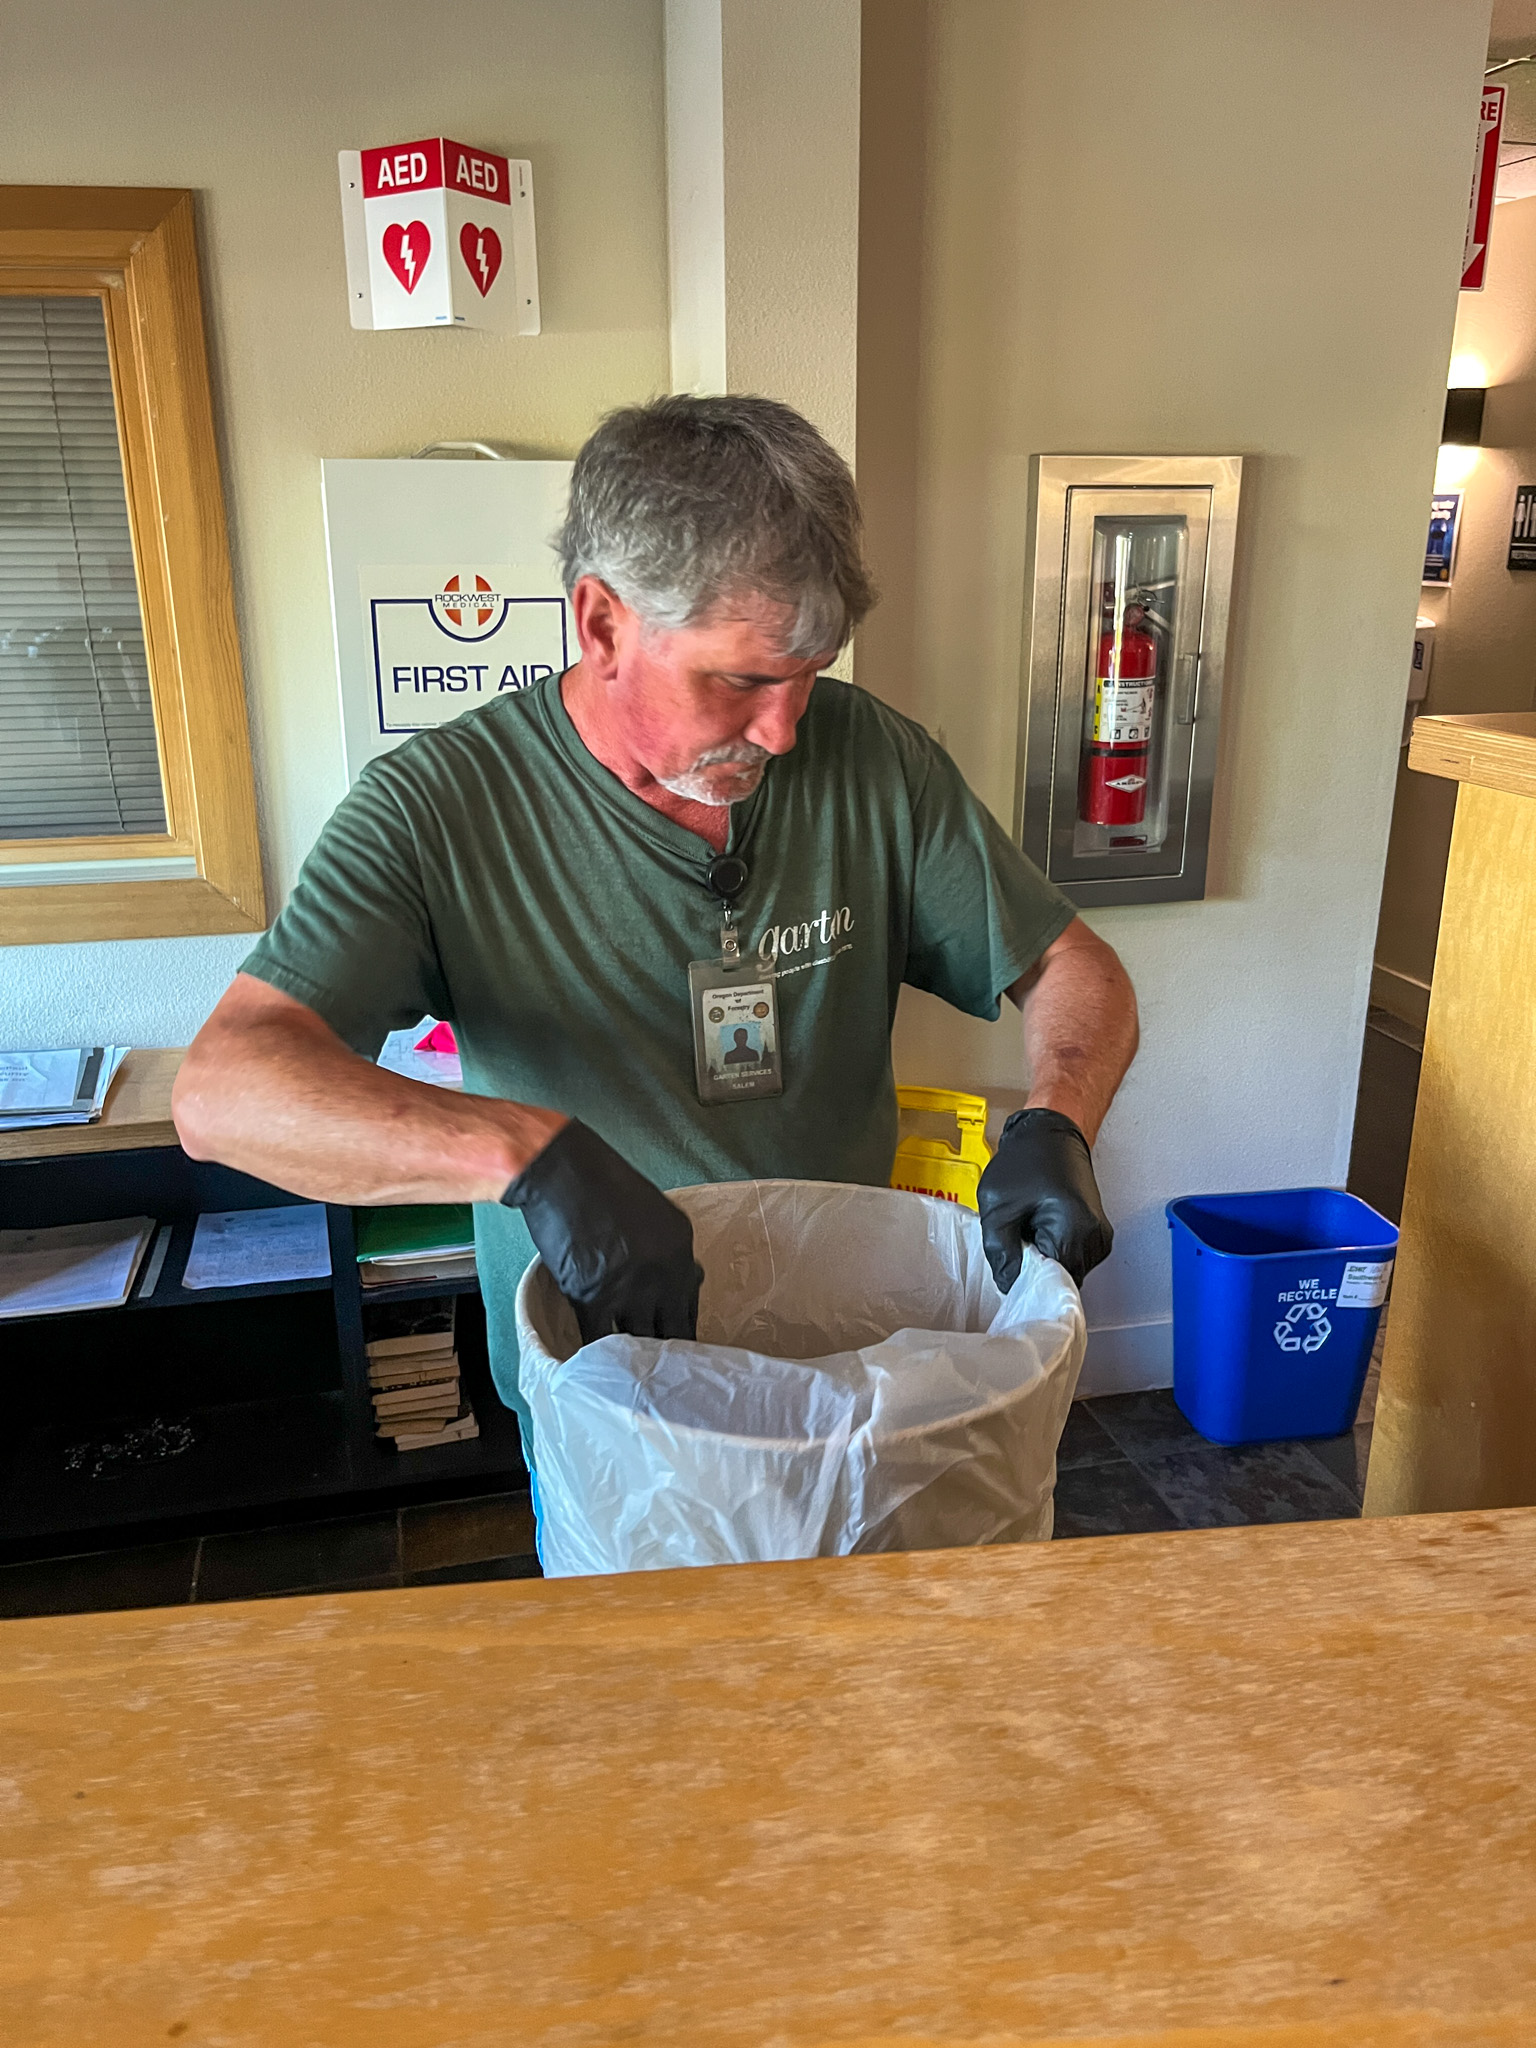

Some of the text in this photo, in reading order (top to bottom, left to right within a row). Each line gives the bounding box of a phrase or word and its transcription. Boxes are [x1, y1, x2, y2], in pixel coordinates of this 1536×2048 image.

[1480, 101, 1498, 121] RE
[377, 152, 428, 189] AED
[456, 154, 499, 193] AED
[434, 594, 501, 602] ROCKWEST
[392, 665, 489, 693] FIRST
[733, 989, 764, 998] Department
[740, 1068, 772, 1078] SERVICES
[732, 1081, 755, 1090] SALEM
[1298, 1278, 1320, 1290] WE
[1277, 1288, 1338, 1303] RECYCLE
